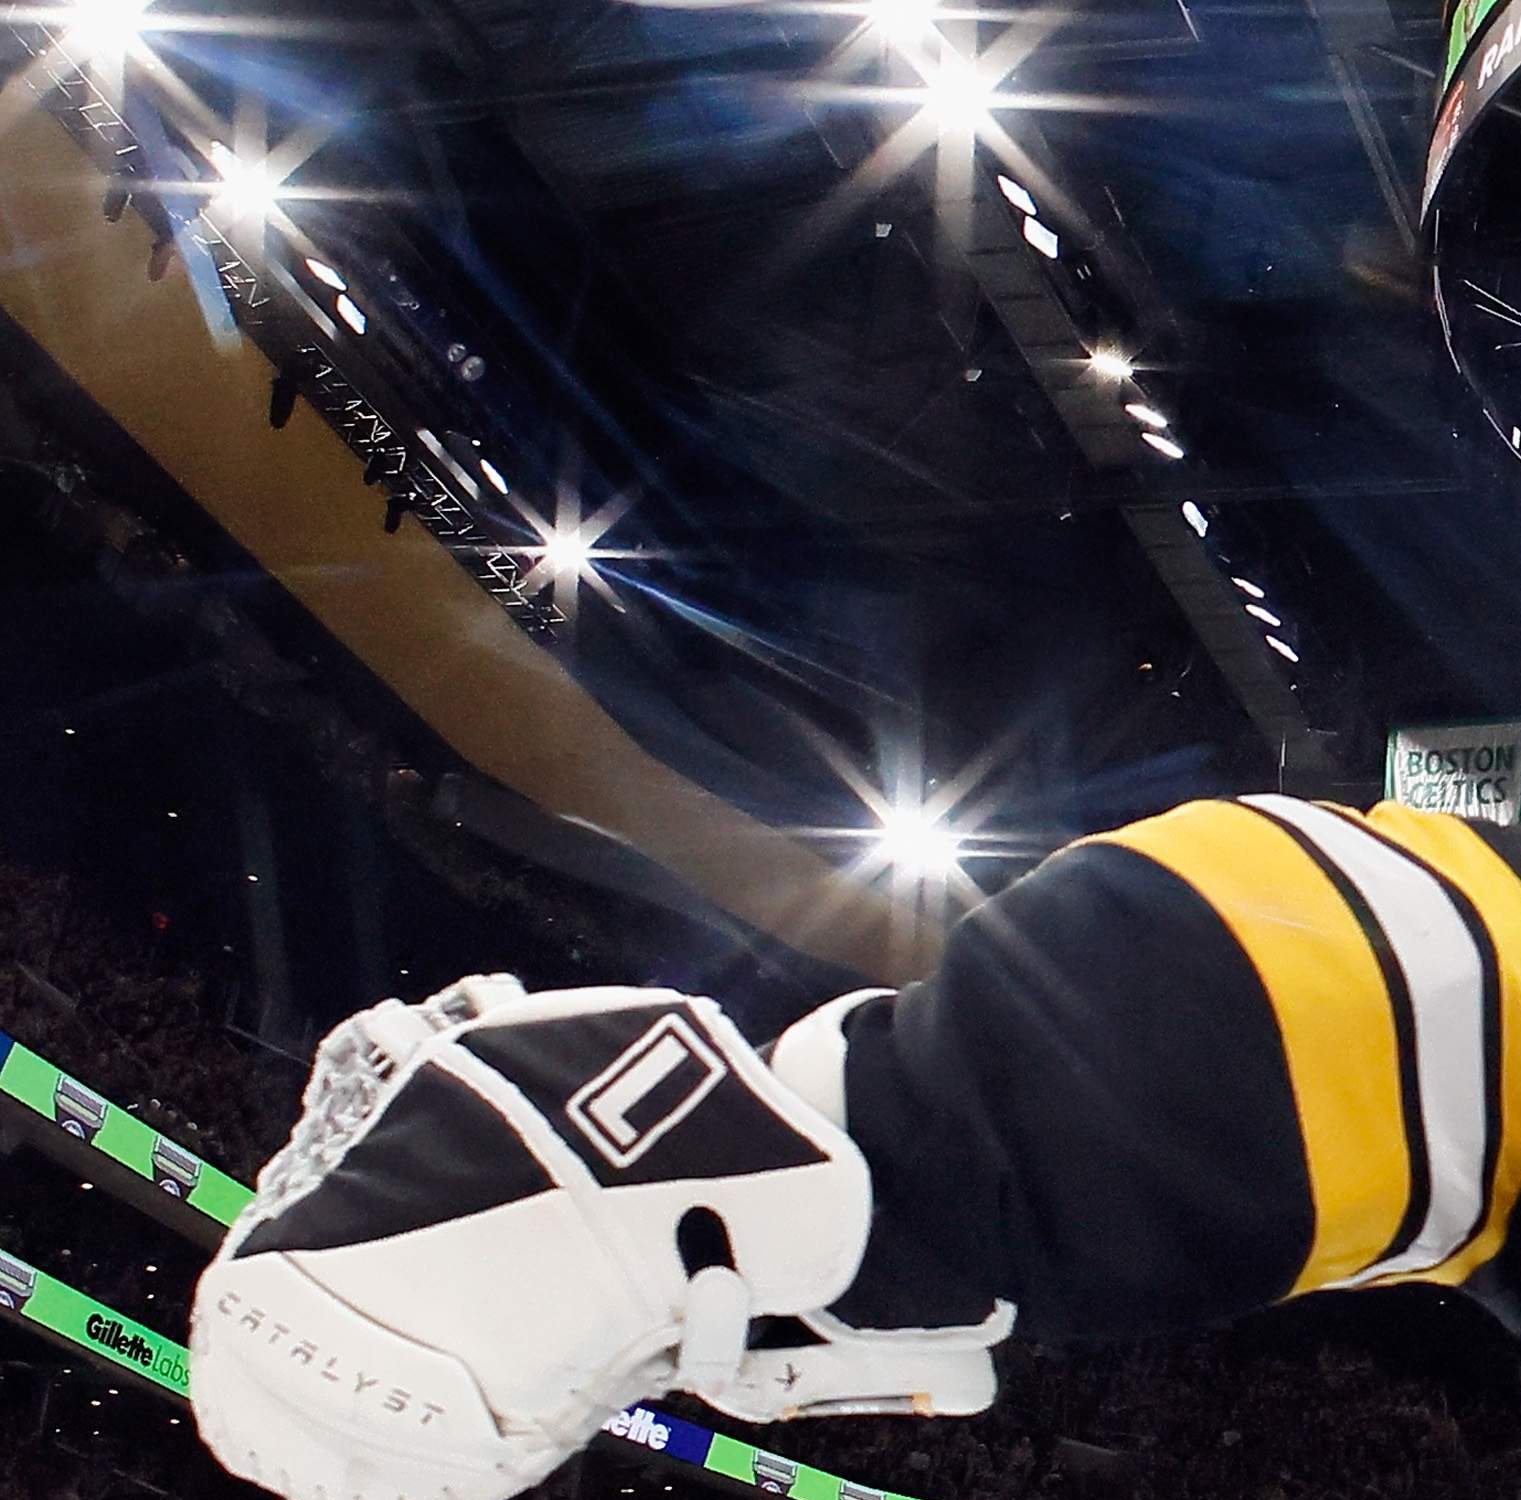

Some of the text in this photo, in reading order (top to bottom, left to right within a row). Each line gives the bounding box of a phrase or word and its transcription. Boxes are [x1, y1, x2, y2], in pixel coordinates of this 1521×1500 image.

[1407, 744, 1515, 776] BOSTON
[217, 1289, 447, 1428] CATALYST
[602, 1407, 670, 1451] ette
